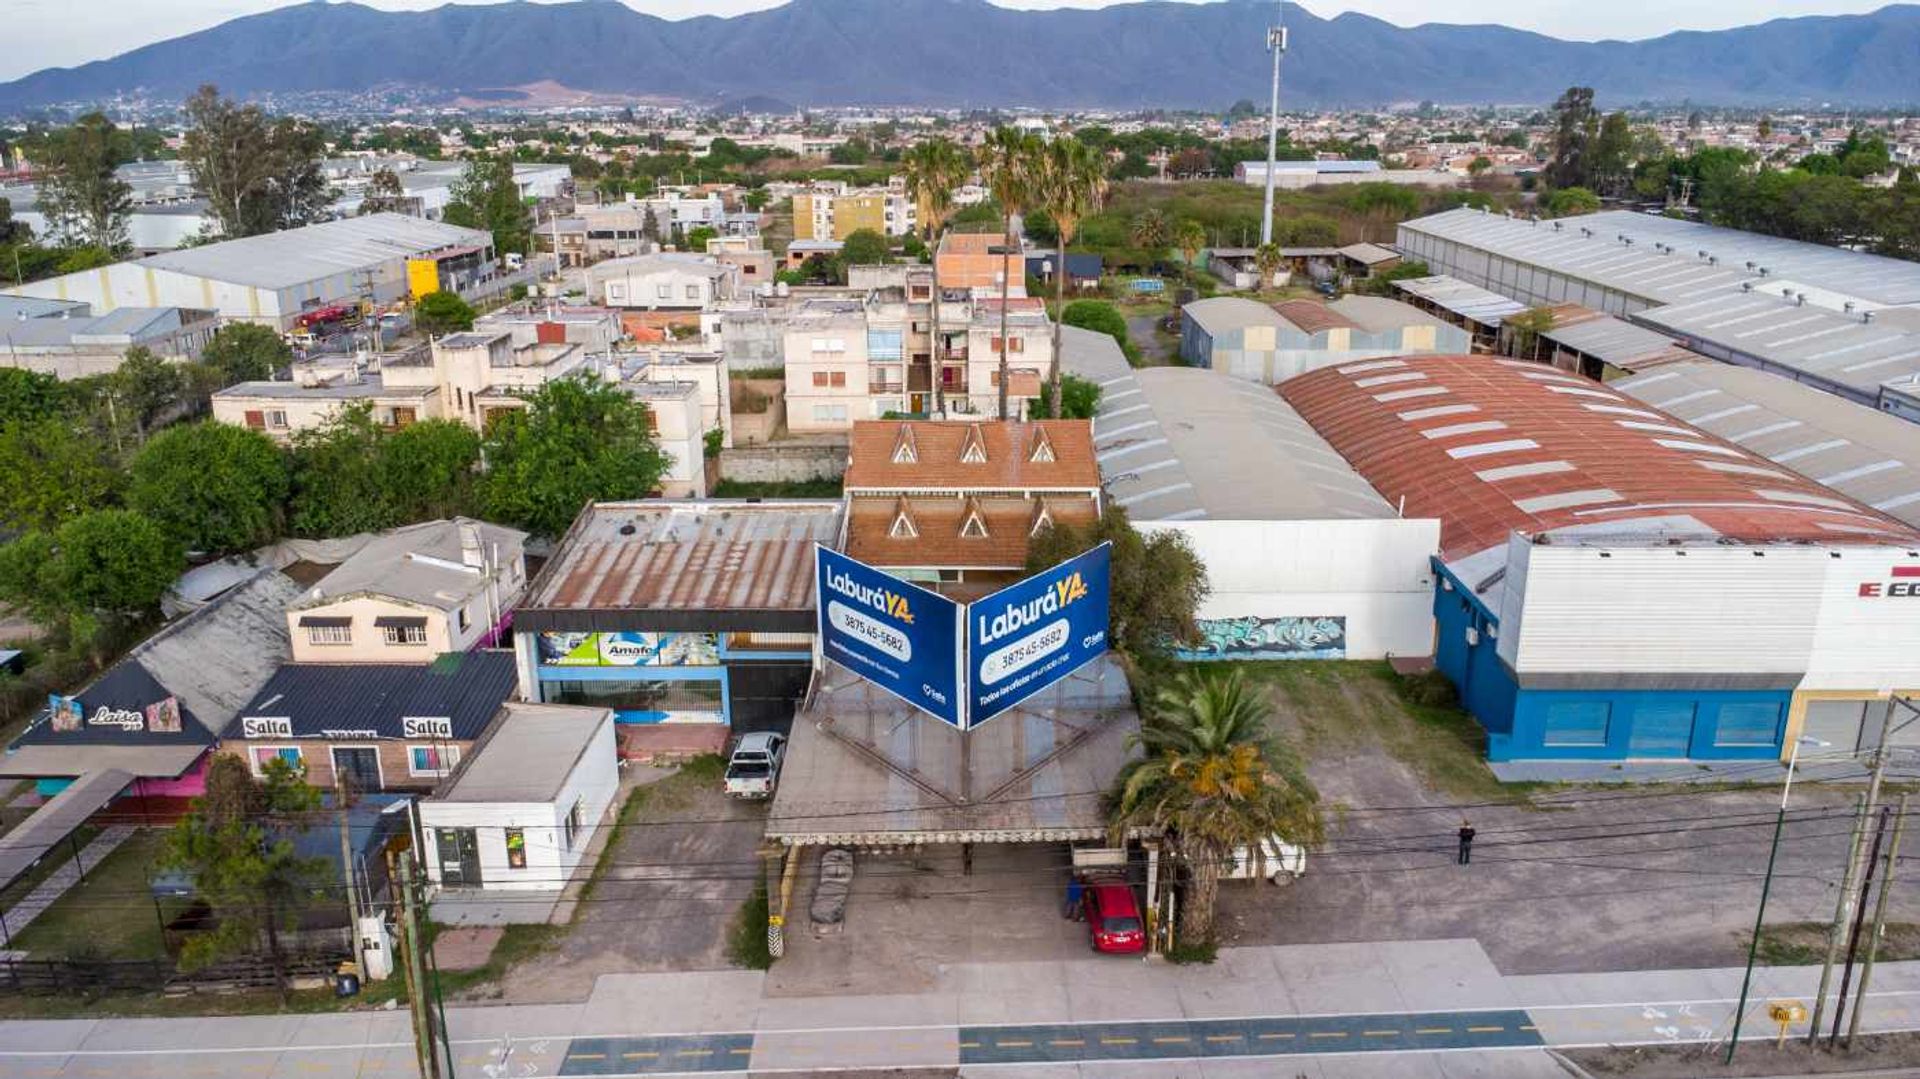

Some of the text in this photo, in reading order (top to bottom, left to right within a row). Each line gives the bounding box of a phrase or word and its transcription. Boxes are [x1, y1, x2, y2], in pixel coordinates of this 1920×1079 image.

[1002, 648, 1024, 669] 3875
[245, 720, 288, 735] Salta
[405, 720, 448, 736] Salta
